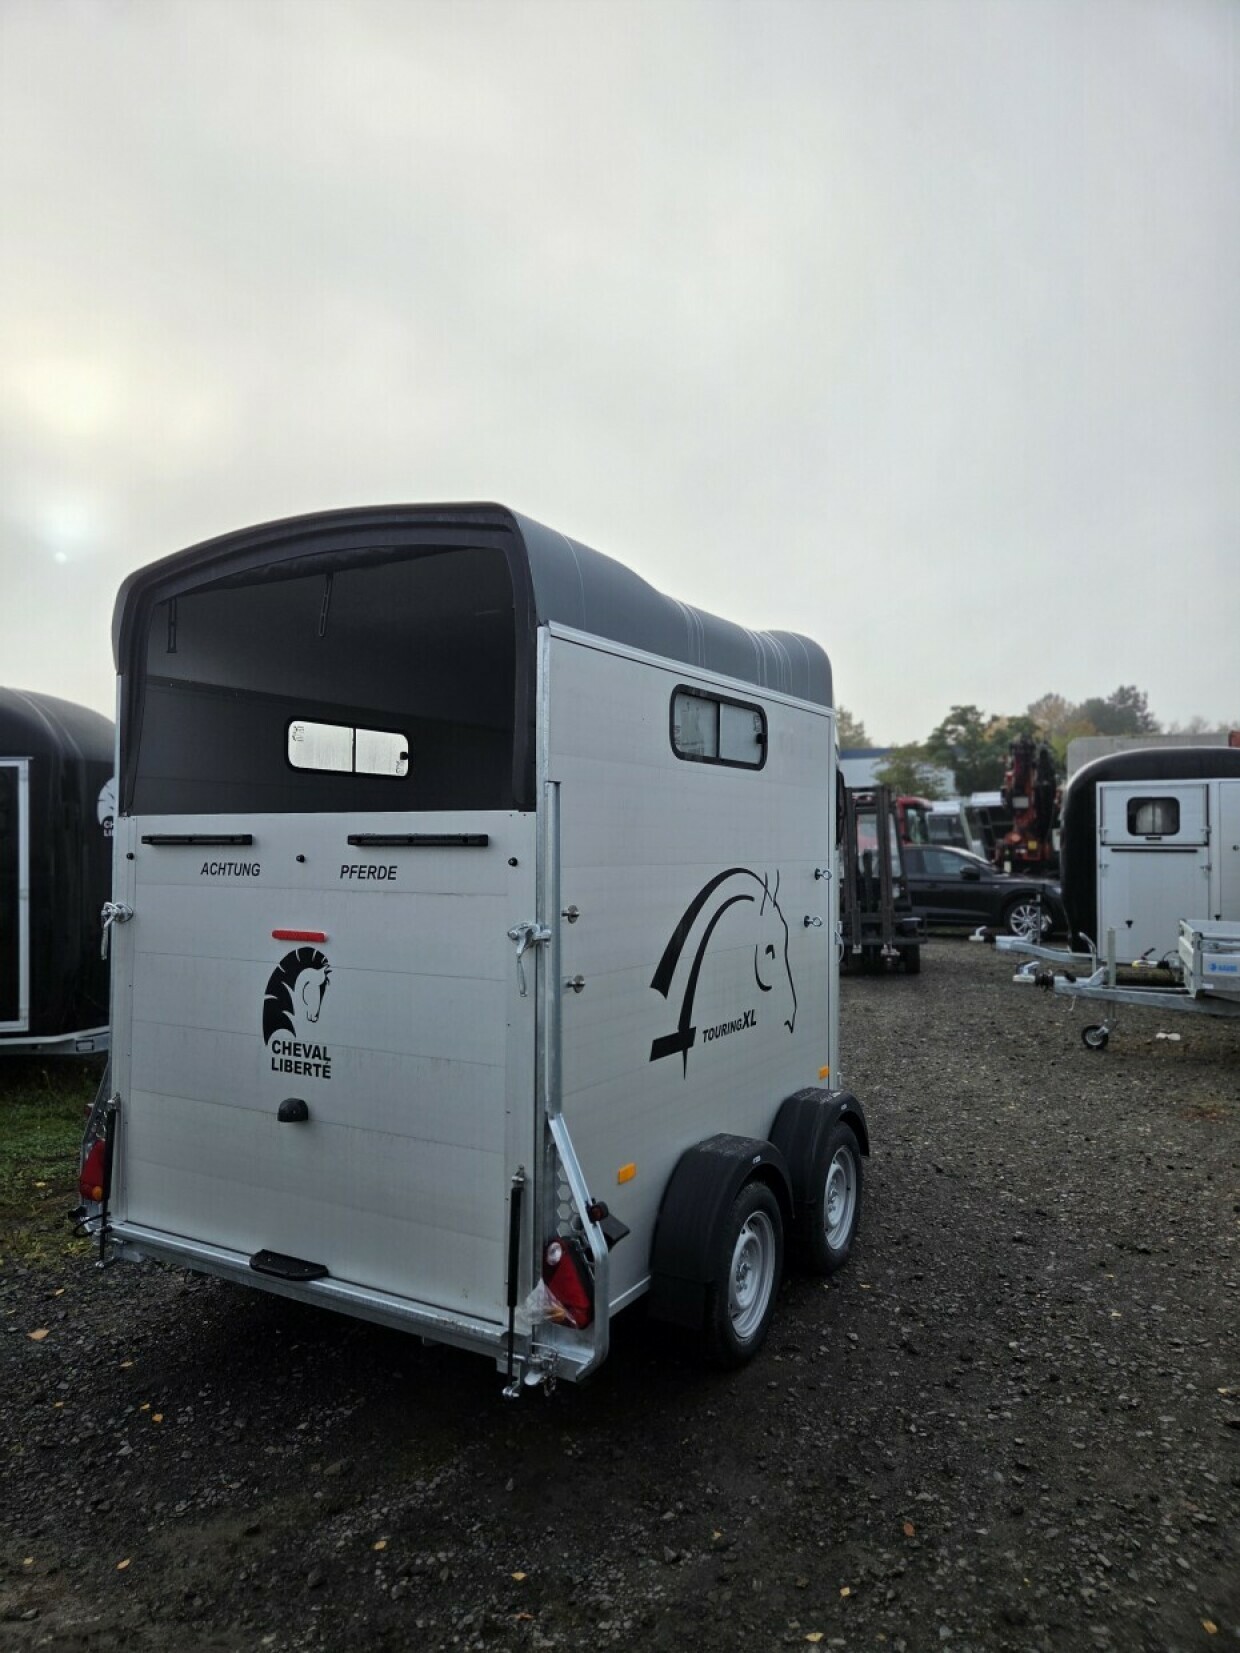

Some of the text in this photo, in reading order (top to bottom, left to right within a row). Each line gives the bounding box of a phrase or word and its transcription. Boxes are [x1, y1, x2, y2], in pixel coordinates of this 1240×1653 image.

[200, 861, 398, 881] ACHTUNG PFERDE
[271, 1039, 332, 1062] CHEVAL
[271, 1056, 332, 1079] LIBERTÉ
